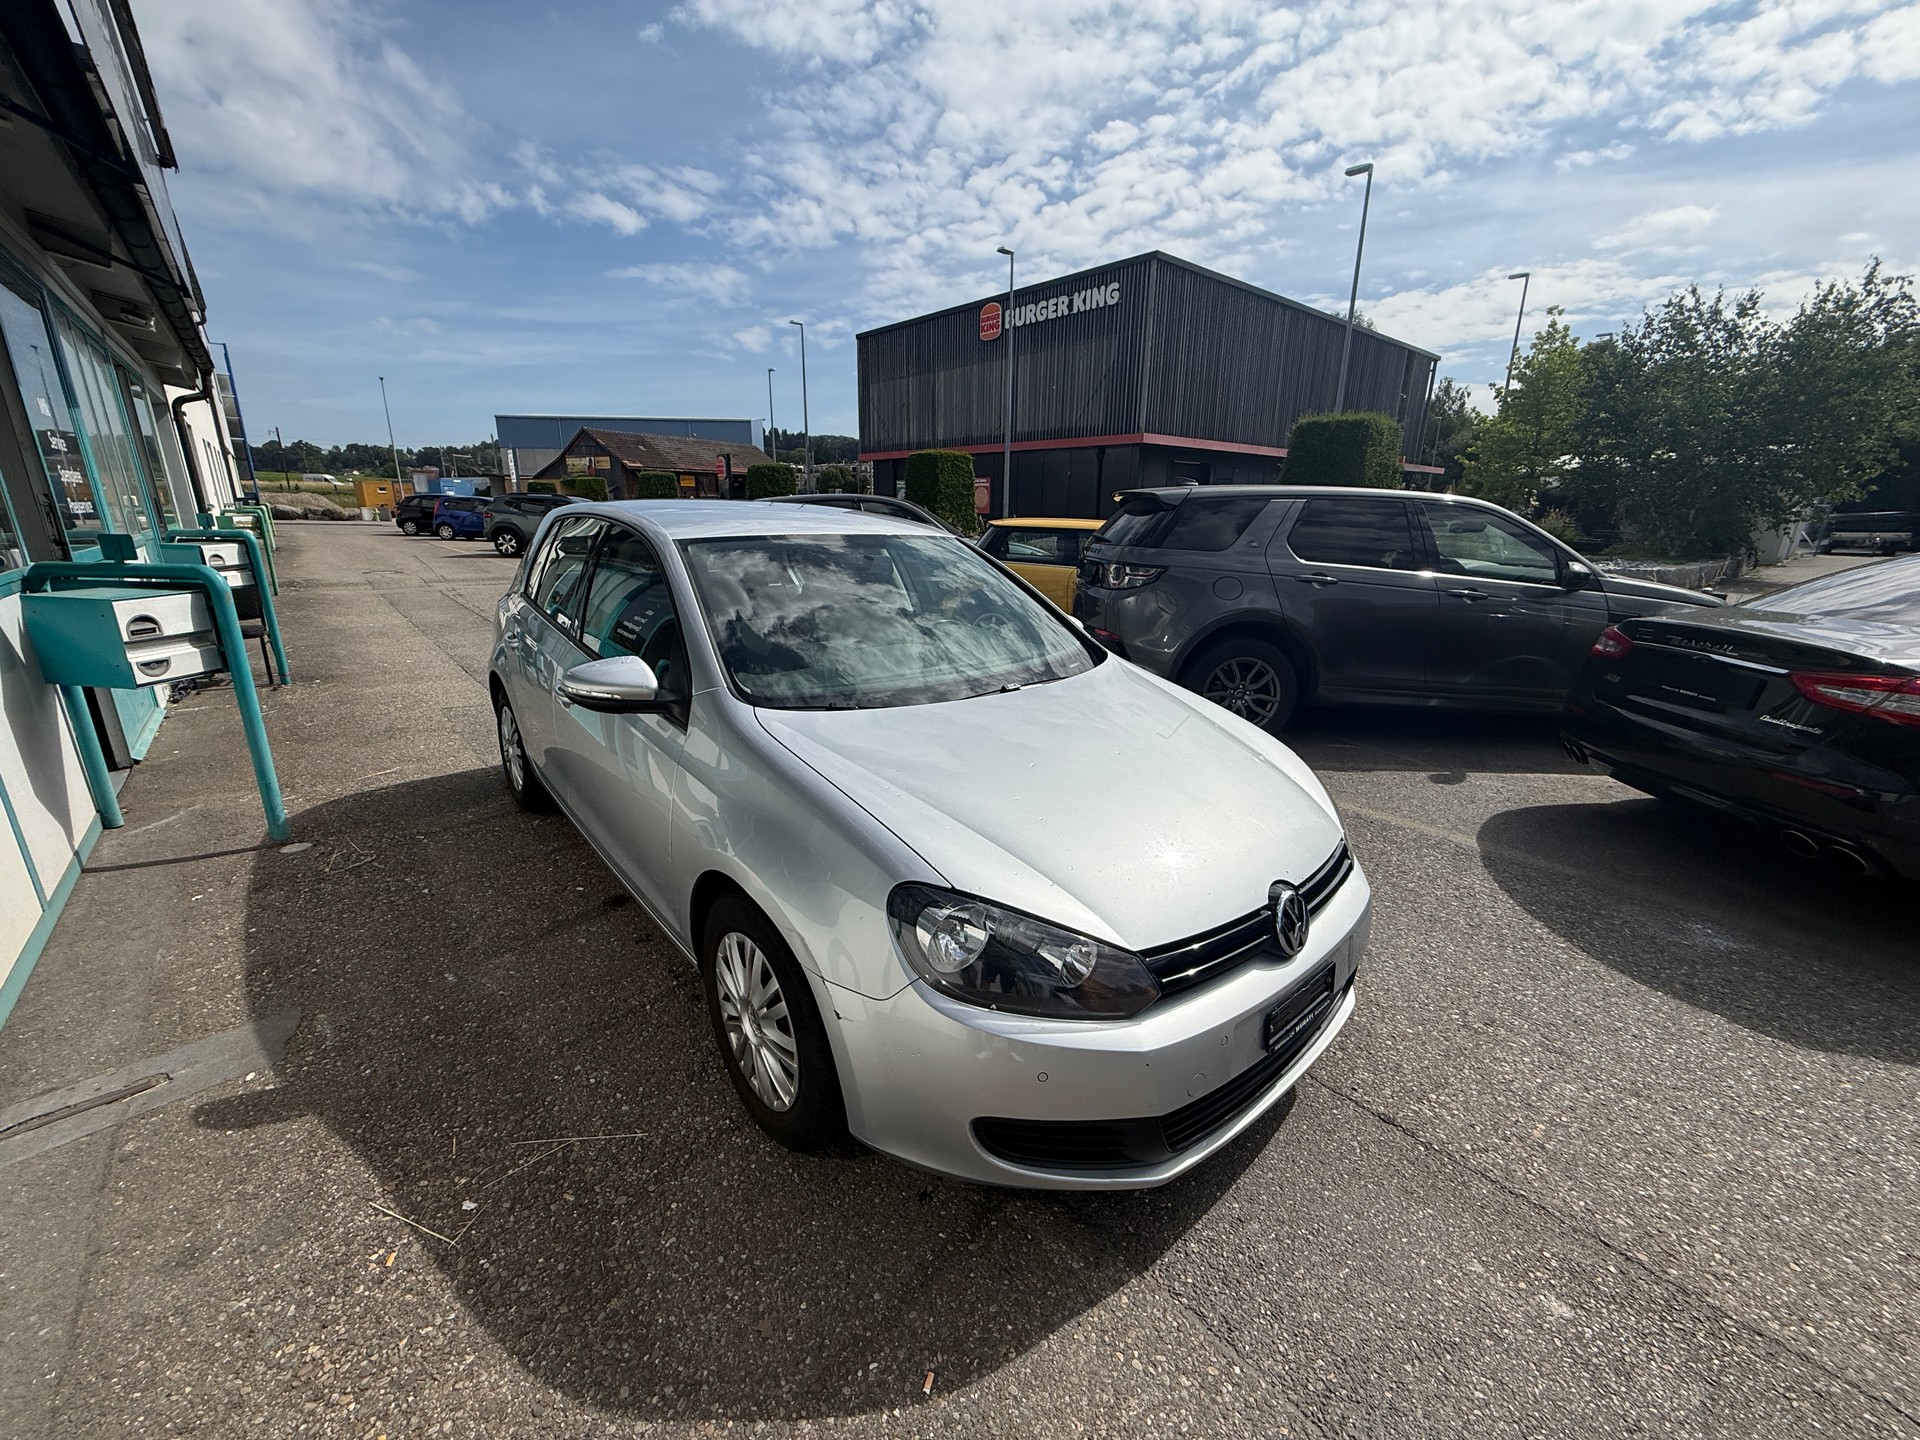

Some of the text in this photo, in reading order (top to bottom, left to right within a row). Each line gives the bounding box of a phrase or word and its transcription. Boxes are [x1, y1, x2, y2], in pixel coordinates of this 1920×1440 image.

[1005, 282, 1120, 330] BURGER KING
[981, 312, 1000, 323] BURGER
[981, 320, 1000, 334] KING
[47, 431, 68, 451] Service
[57, 465, 83, 487] Spenglerei
